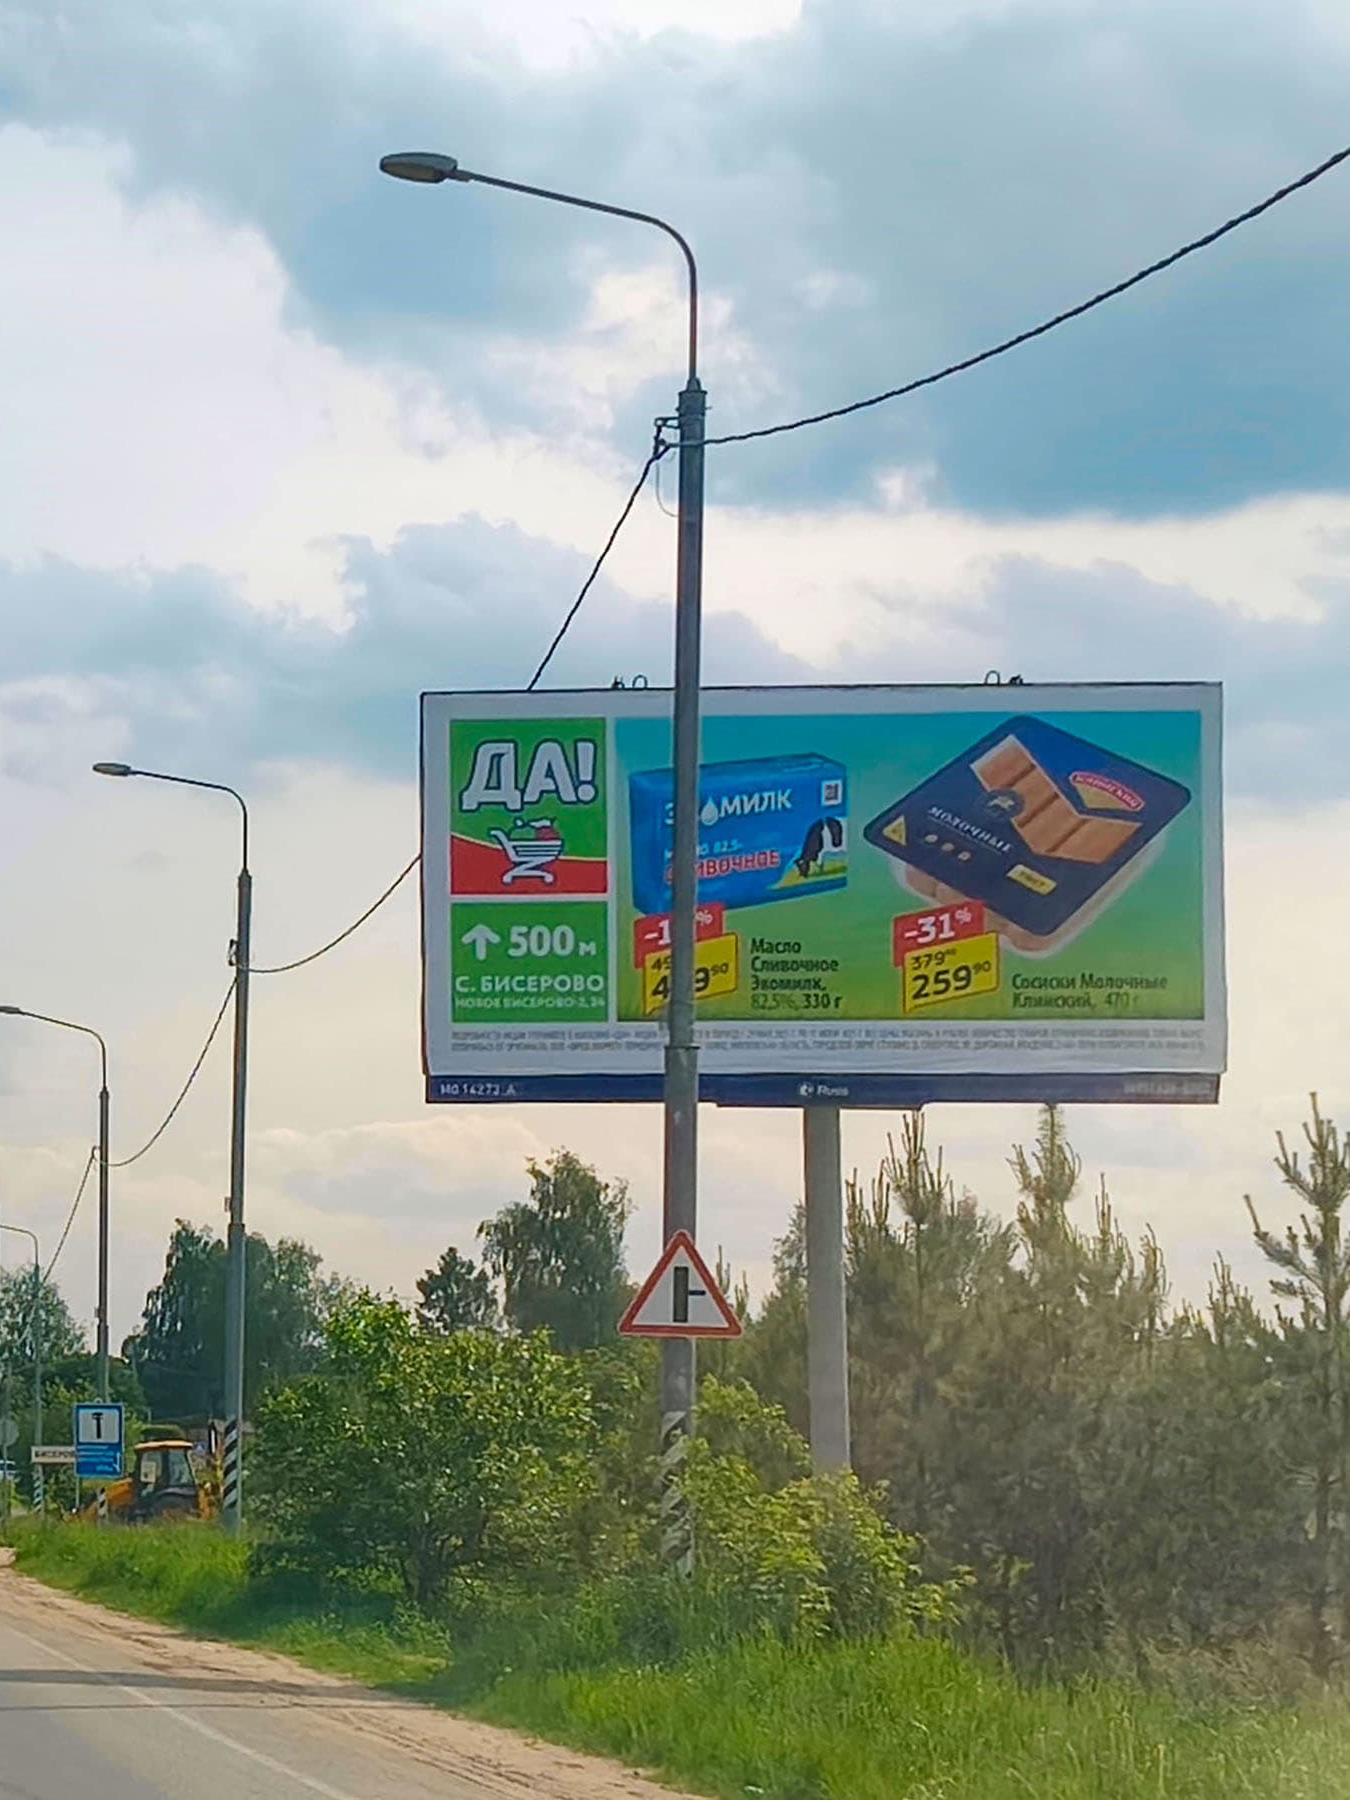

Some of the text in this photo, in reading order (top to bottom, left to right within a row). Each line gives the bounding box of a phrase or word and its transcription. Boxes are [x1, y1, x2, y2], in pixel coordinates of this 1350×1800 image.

[461, 739, 596, 811] ДА!
[664, 850, 781, 885] СИВОЧНОЕ
[507, 924, 575, 957] 500
[751, 938, 802, 954] Масло
[751, 956, 839, 973] Сливочное
[480, 974, 605, 993] БИСЕРОВО
[651, 966, 710, 1000] 49
[751, 975, 827, 991] Экомилк,
[911, 964, 972, 1000] 259
[1011, 972, 1168, 990] Сосиски Молочные
[802, 993, 832, 1009] 330
